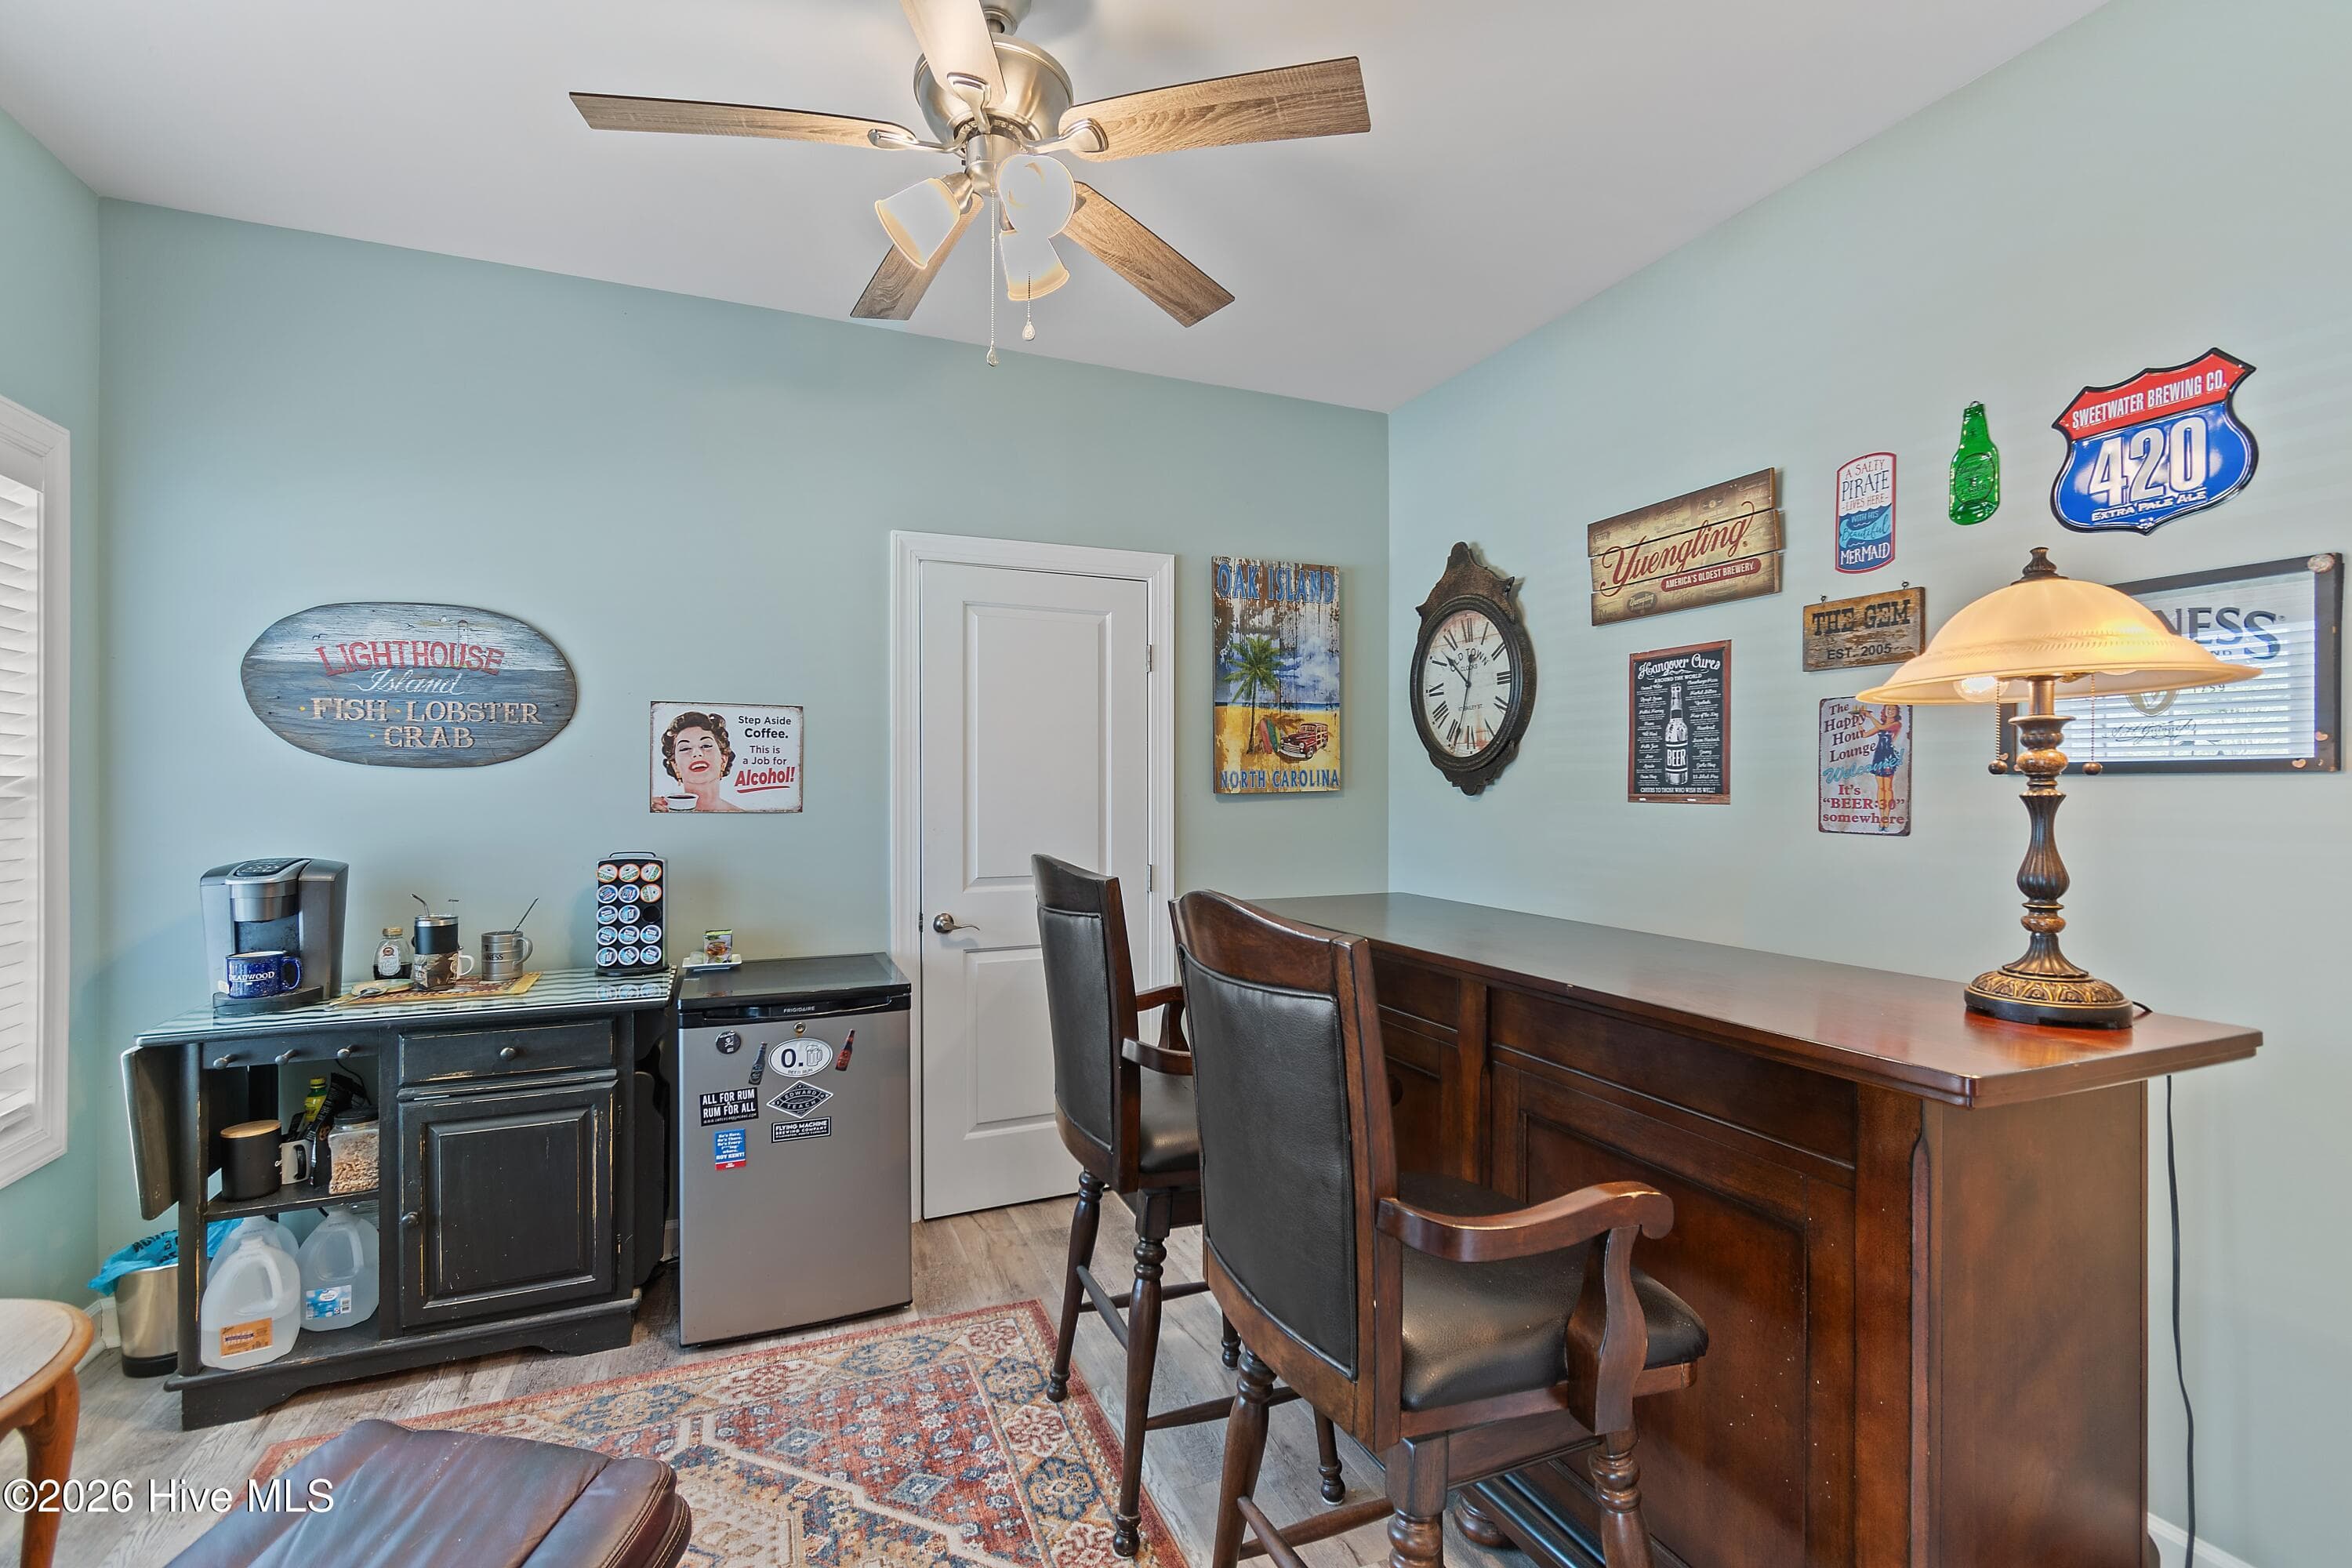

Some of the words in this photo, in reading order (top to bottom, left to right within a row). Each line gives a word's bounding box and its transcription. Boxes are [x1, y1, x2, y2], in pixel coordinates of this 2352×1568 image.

[2072, 391, 2144, 430] SWEETWATER
[2147, 375, 2201, 408] BREWING
[2206, 369, 2227, 391] CO.
[1845, 469, 1853, 480] A
[1855, 459, 1886, 476] SALTY
[2088, 417, 2207, 506] 420
[1842, 470, 1889, 501] PIRATE
[1851, 512, 1867, 523] WITH
[1867, 510, 1879, 521] HIS
[2091, 506, 2135, 521] EXTRA
[2138, 498, 2174, 512] PALE
[2176, 492, 2206, 503] ALE
[1842, 514, 1890, 541] Beautiful
[1600, 500, 1755, 597] Yuengling
[1840, 542, 1890, 565] MERMAID
[1217, 563, 1261, 601] OAK
[1267, 564, 1334, 604] ISLAND
[1665, 573, 1697, 590] AMERICA'S
[1698, 568, 1722, 584] OLDEST
[1812, 608, 1854, 636] THE
[1864, 599, 1911, 629] GEM
[2151, 607, 2281, 660] NESS
[315, 641, 506, 676] LIGHTHOUSE
[1465, 648, 1491, 666] TOWN
[1828, 648, 1856, 660] EST.
[1861, 644, 1892, 656] 2005
[1638, 659, 1689, 680] Hangover
[1692, 653, 1721, 670] Cures
[353, 669, 465, 695] Island
[310, 698, 389, 722] FISH
[406, 700, 543, 724] LOBSTER
[1829, 703, 1849, 716] The
[739, 715, 761, 726] Step
[764, 716, 792, 725] Aside
[1824, 712, 1866, 733] Happy
[384, 725, 475, 749] CRAB
[744, 728, 789, 739] Coffee.
[1832, 729, 1865, 746] Hour
[750, 745, 770, 753] This
[772, 745, 780, 753] is
[1667, 749, 1686, 767] BEER
[1830, 742, 1876, 763] Lounge
[751, 757, 770, 765] Job
[734, 766, 796, 787] Alcohol!
[1221, 769, 1266, 789] NORTH
[1272, 768, 1340, 789] CAROLINA
[1838, 784, 1861, 796] It's
[1823, 813, 1905, 824] somewhere
[228, 971, 275, 981] DEADWOOD
[702, 1094, 717, 1105] ALL
[720, 1091, 735, 1103] FOR
[737, 1088, 755, 1101] RUM
[784, 1090, 817, 1099] EDWARD
[786, 1100, 815, 1109] TEACH
[703, 1106, 720, 1118] RUM
[724, 1104, 739, 1116] FOR
[741, 1102, 756, 1113] ALL
[799, 1120, 827, 1128] MACHINE
